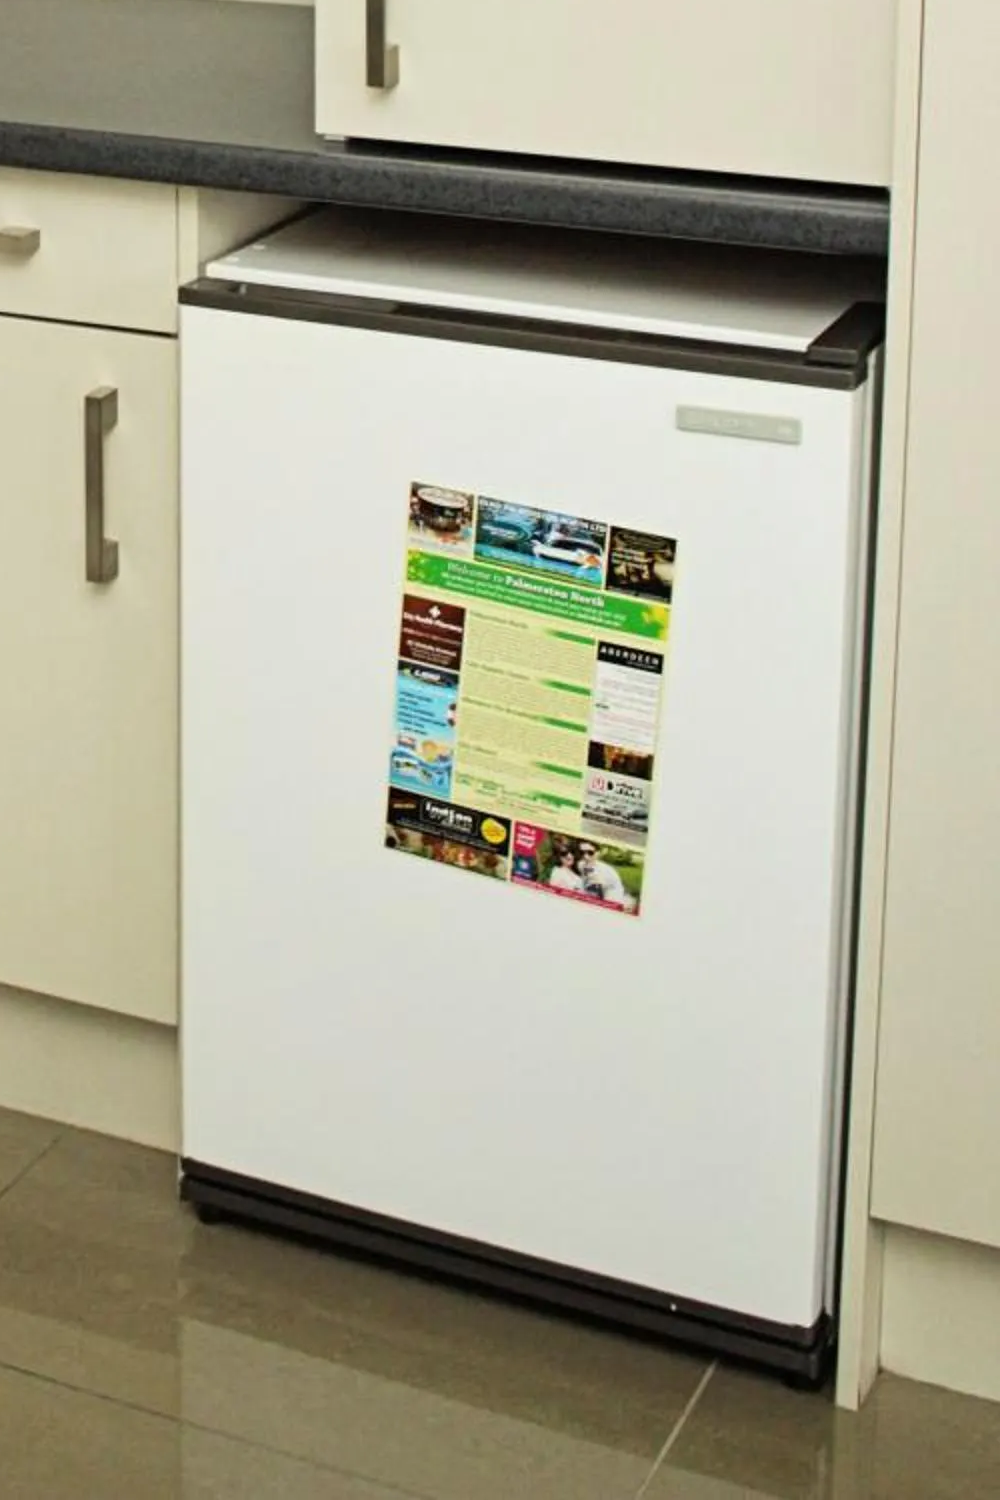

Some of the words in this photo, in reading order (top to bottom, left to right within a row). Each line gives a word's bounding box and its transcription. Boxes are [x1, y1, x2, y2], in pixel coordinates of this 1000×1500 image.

[505, 574, 569, 600] Palmerston
[570, 590, 606, 608] North
[599, 645, 660, 666] ABERDEEN
